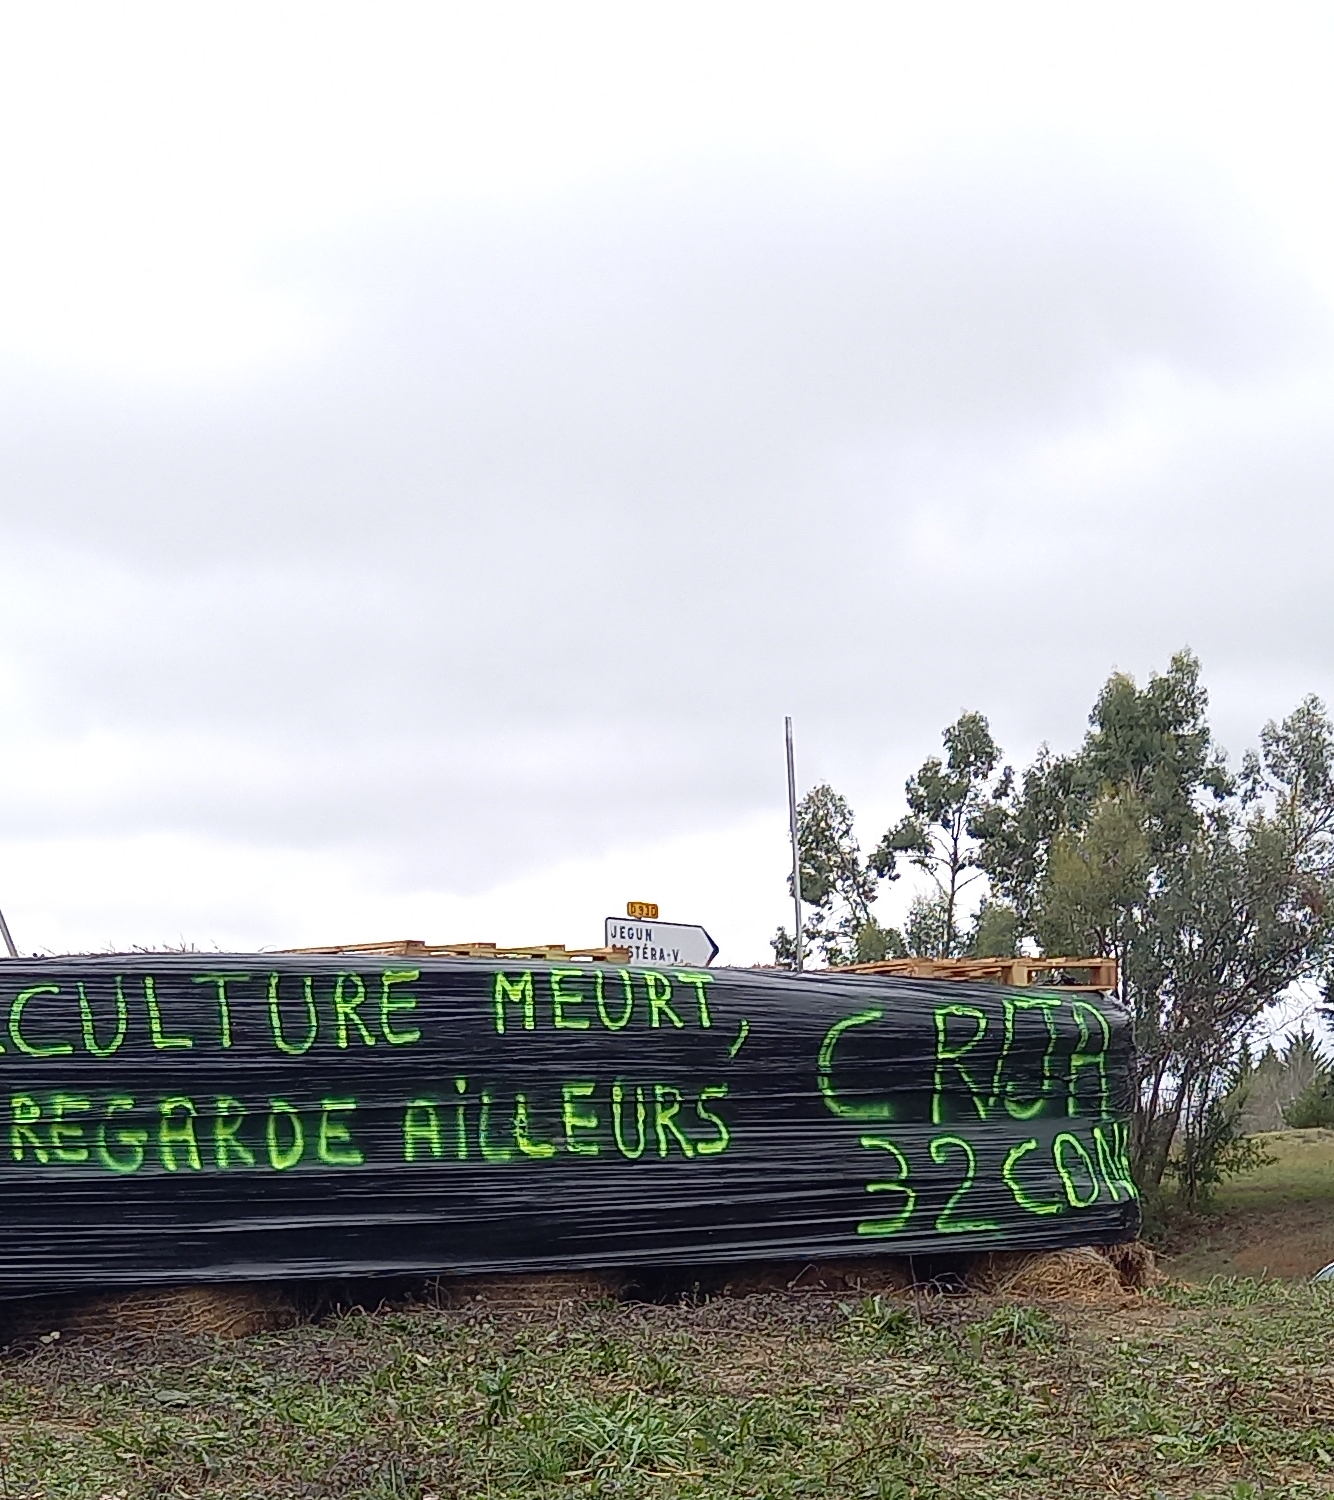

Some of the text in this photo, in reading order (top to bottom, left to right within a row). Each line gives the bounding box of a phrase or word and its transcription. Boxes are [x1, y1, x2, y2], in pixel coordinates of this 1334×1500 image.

[611, 926, 653, 942] JEGUN
[493, 968, 750, 1058] MEURT,
[9, 1092, 365, 1172] REGARDE
